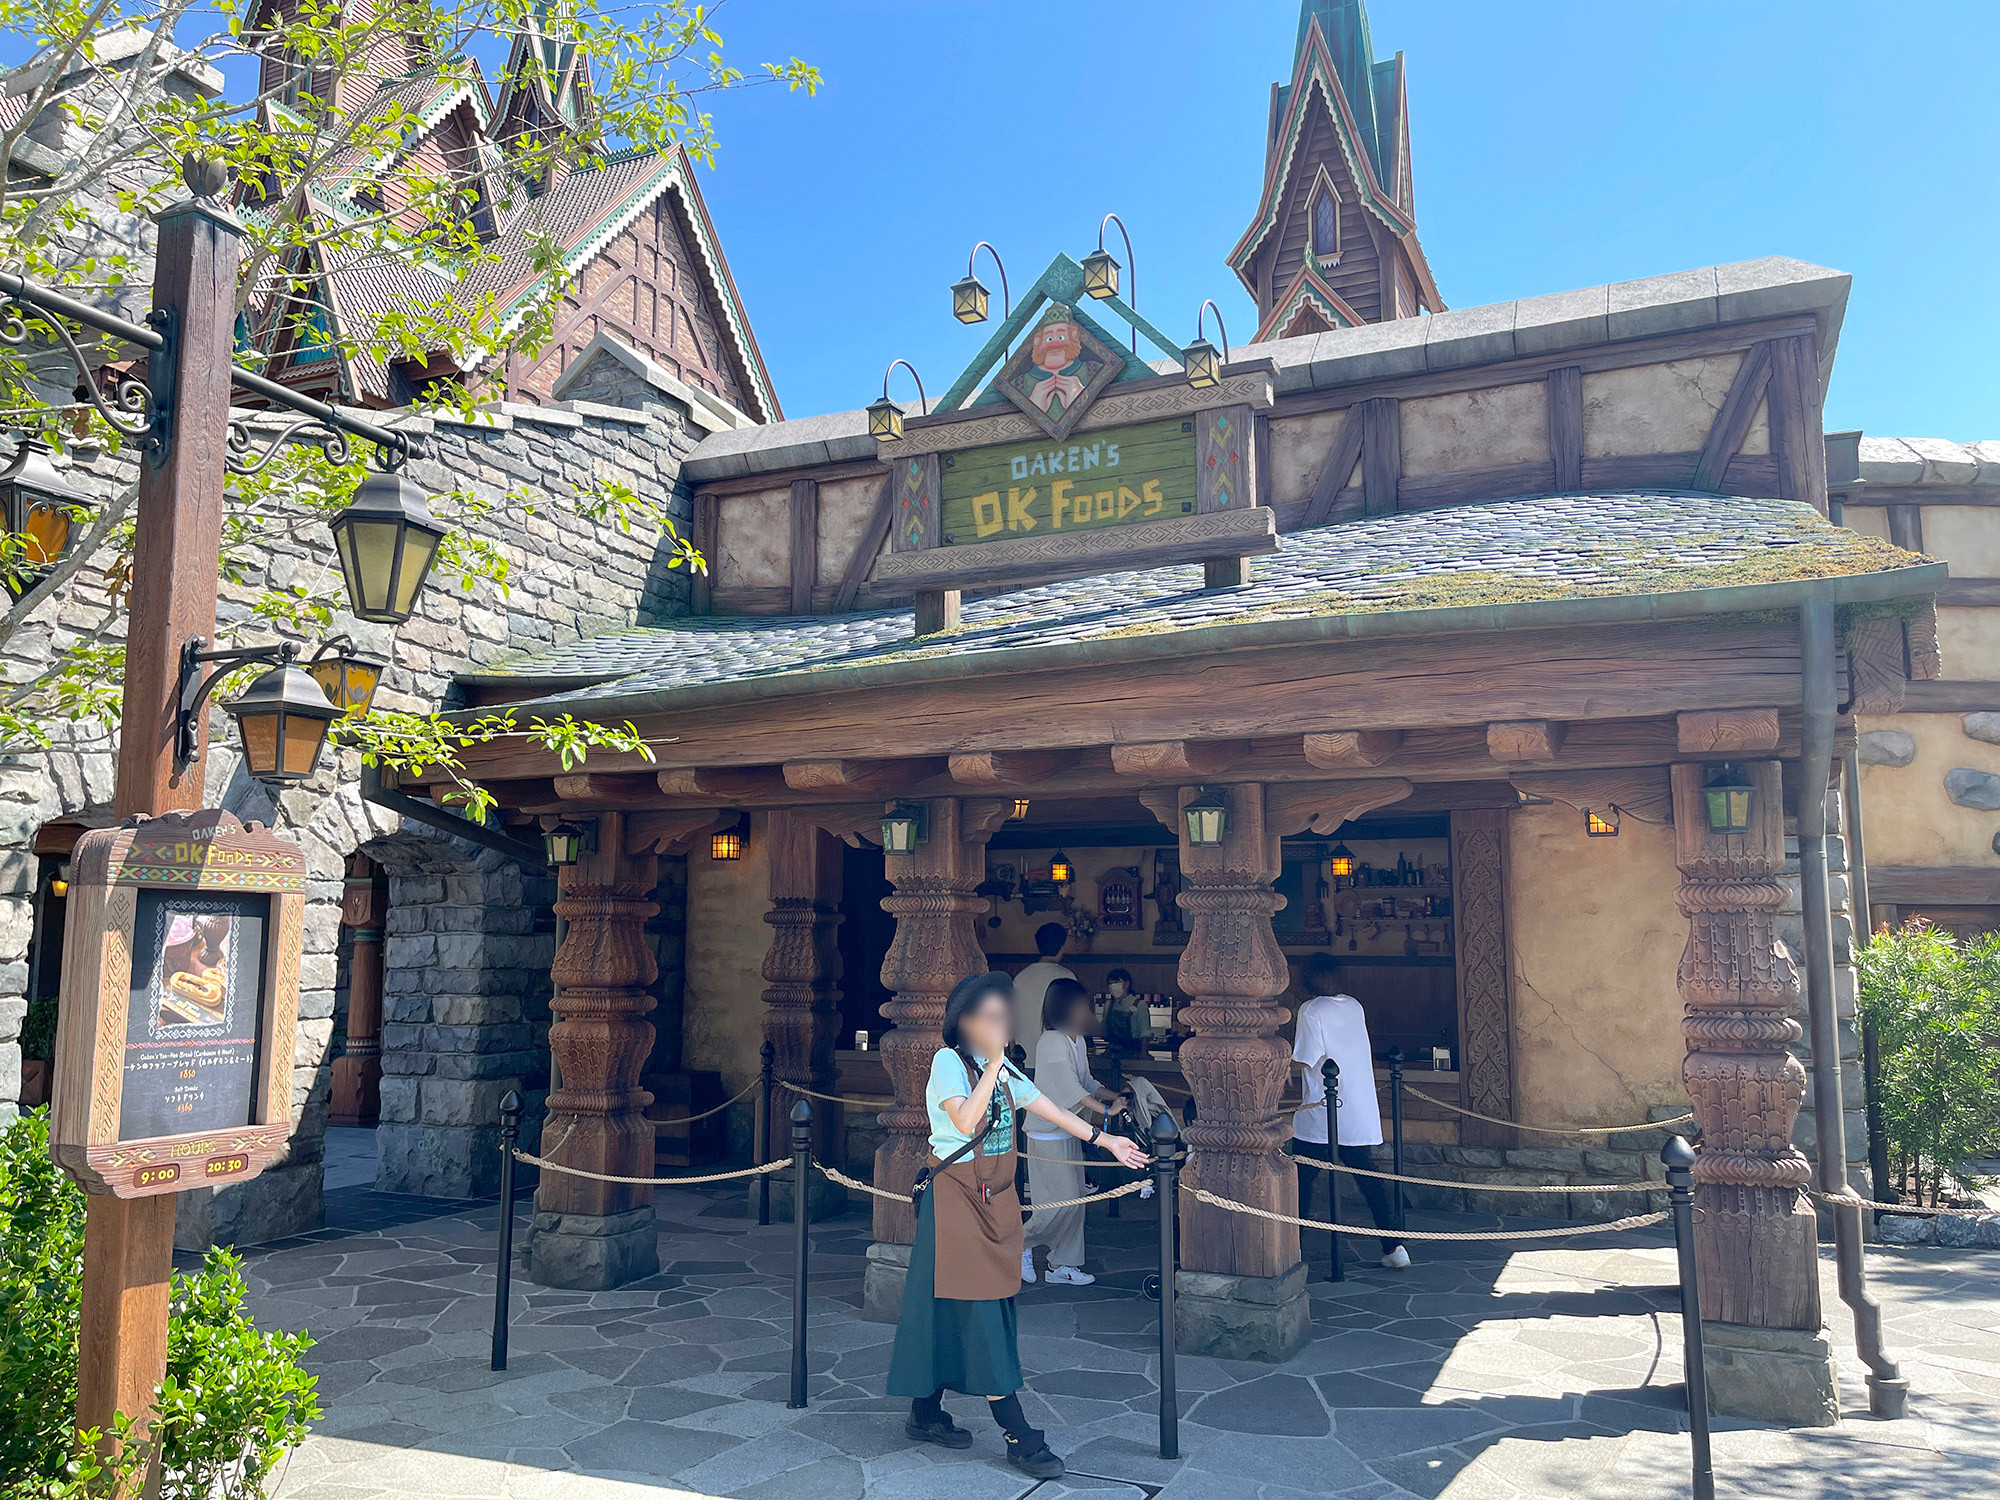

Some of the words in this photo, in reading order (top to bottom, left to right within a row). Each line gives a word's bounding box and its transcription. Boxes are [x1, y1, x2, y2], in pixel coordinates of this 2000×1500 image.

[1010, 439, 1120, 481] OAKEN'S
[971, 485, 1039, 539] OK
[1051, 478, 1163, 529] FOODS
[174, 842, 204, 865] OK
[207, 844, 253, 867] FOODS
[124, 1059, 197, 1072] ーケンのフッフーブレッド
[179, 1069, 196, 1079] ¥850
[170, 1140, 217, 1158] HOURS
[141, 1168, 175, 1185] 9:00
[207, 1159, 242, 1173] 20:30
